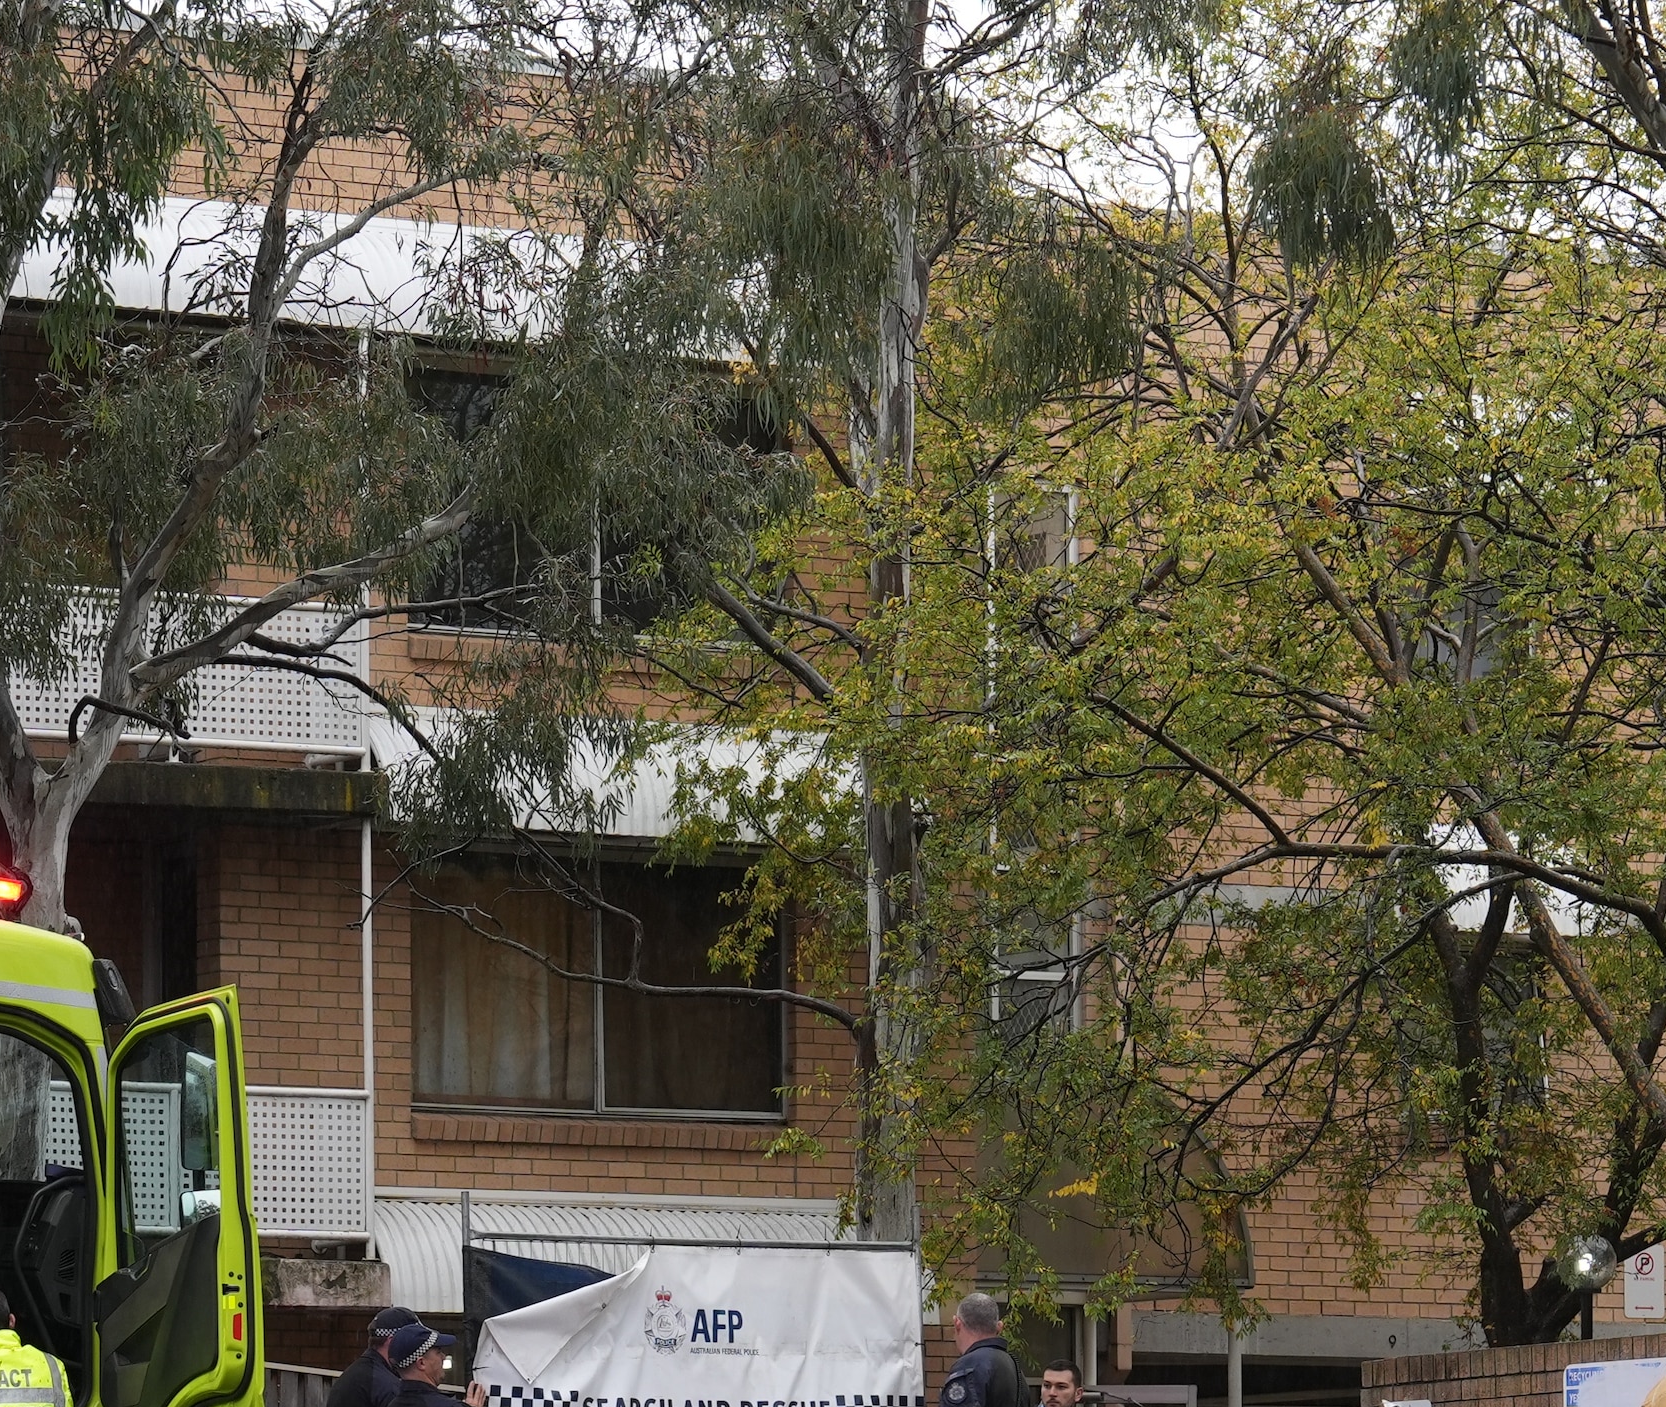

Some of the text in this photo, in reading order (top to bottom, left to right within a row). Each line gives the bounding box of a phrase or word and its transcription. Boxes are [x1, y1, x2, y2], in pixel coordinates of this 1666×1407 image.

[690, 1309, 743, 1344] AFP
[1388, 1334, 1397, 1349] 9
[690, 1347, 761, 1356] AUSTRALIAN FEDERAL POLICE
